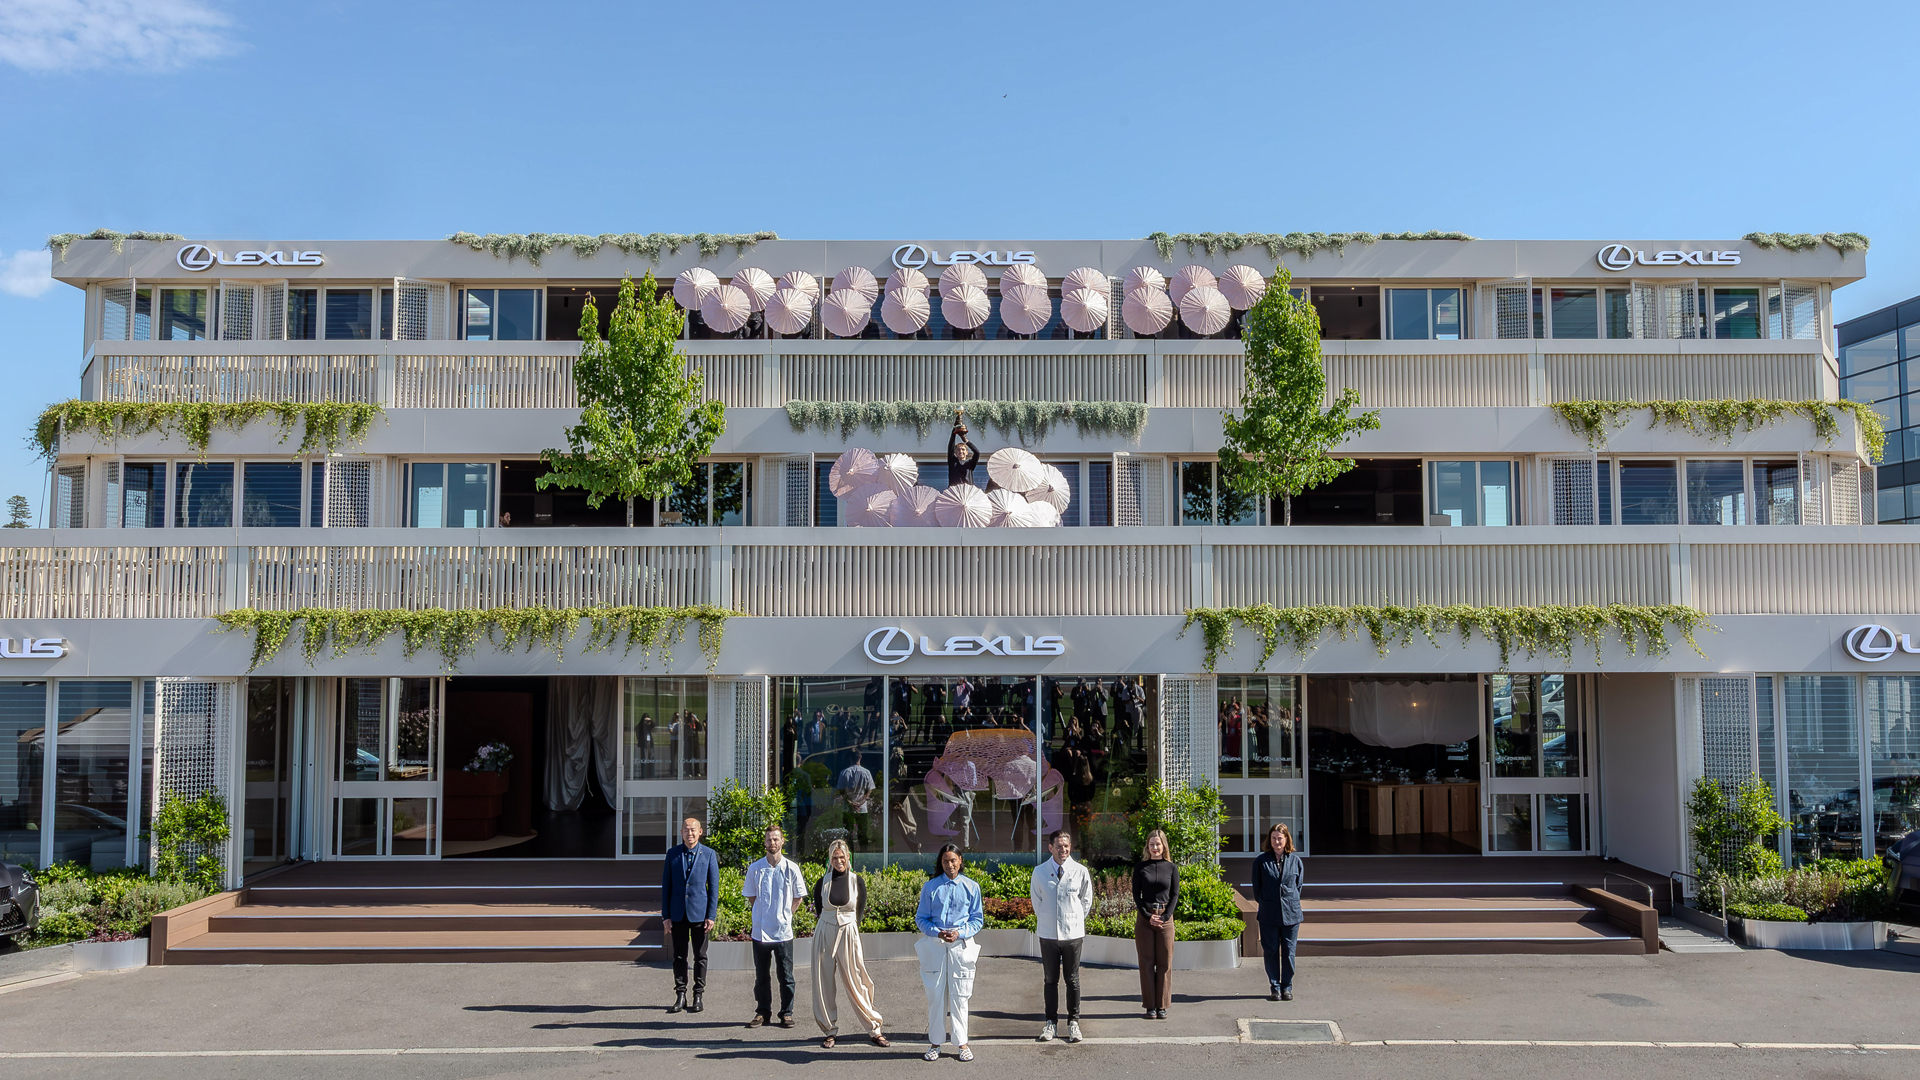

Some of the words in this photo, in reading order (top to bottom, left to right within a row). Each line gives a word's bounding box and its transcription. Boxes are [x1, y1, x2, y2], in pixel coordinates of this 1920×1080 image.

[217, 251, 323, 266] LEXUS
[931, 251, 1036, 265] LEXUS
[1637, 251, 1742, 266] LEXUS
[0, 638, 65, 658] US
[919, 636, 1066, 656] LEXUS
